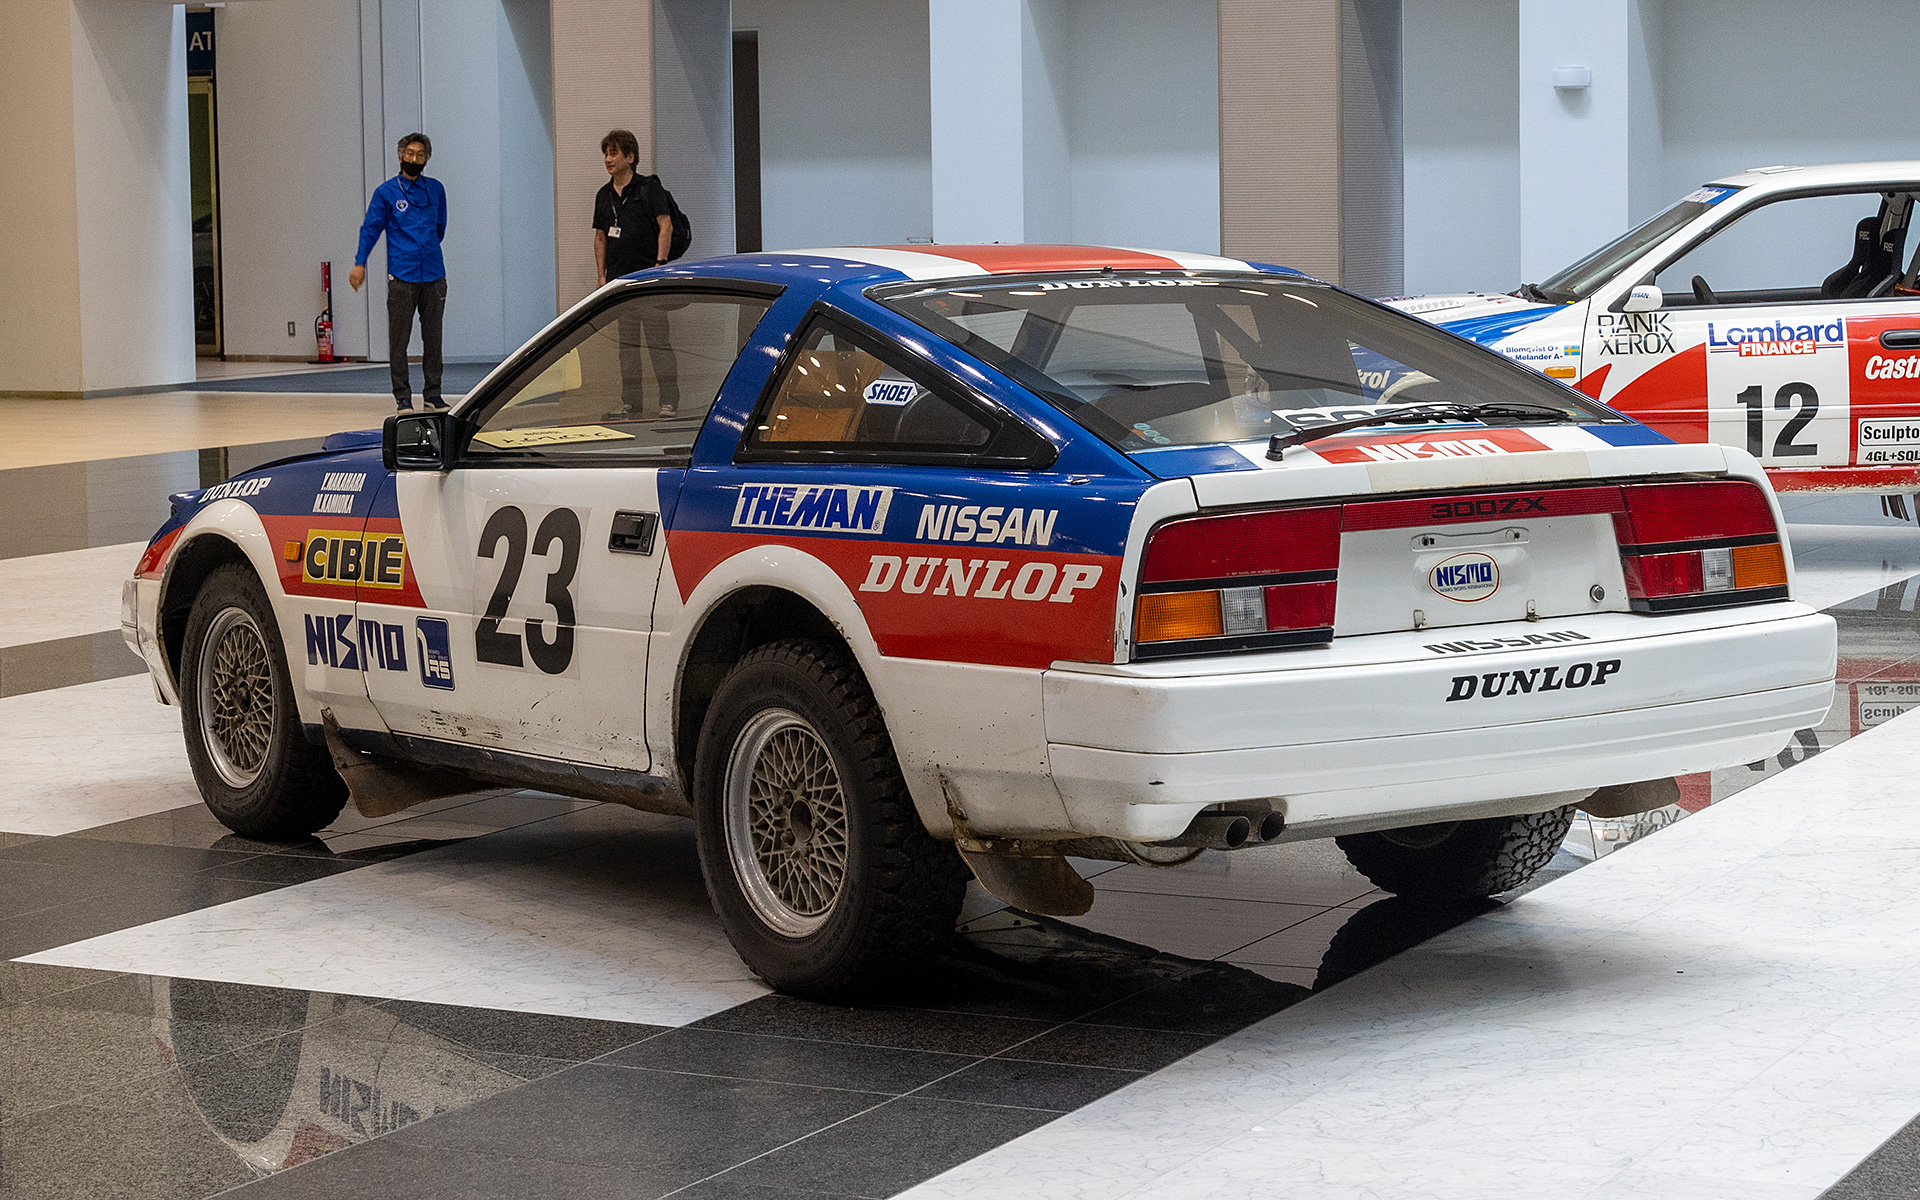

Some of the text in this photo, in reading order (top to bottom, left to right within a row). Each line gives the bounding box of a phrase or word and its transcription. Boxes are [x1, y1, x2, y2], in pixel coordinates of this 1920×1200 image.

[1598, 313, 1672, 334] RANK
[1708, 318, 1844, 346] Lombard
[1600, 332, 1676, 355] XEROX
[1740, 341, 1815, 356] FINANCE
[867, 383, 913, 402] SHOEI
[1736, 382, 1819, 458] 12
[1355, 439, 1500, 461] NISMO
[198, 477, 272, 504] DUNLOP
[1431, 496, 1547, 518] 300ZX
[916, 504, 1058, 546] NISSAN
[305, 535, 404, 585] CIBIÉ
[858, 554, 1104, 603] DUNLOP
[1436, 561, 1492, 587] NISMO
[475, 505, 582, 675] 23
[304, 613, 408, 672] NISMO
[1422, 630, 1591, 655] NISSAN
[1446, 659, 1622, 703] DUNLOP
